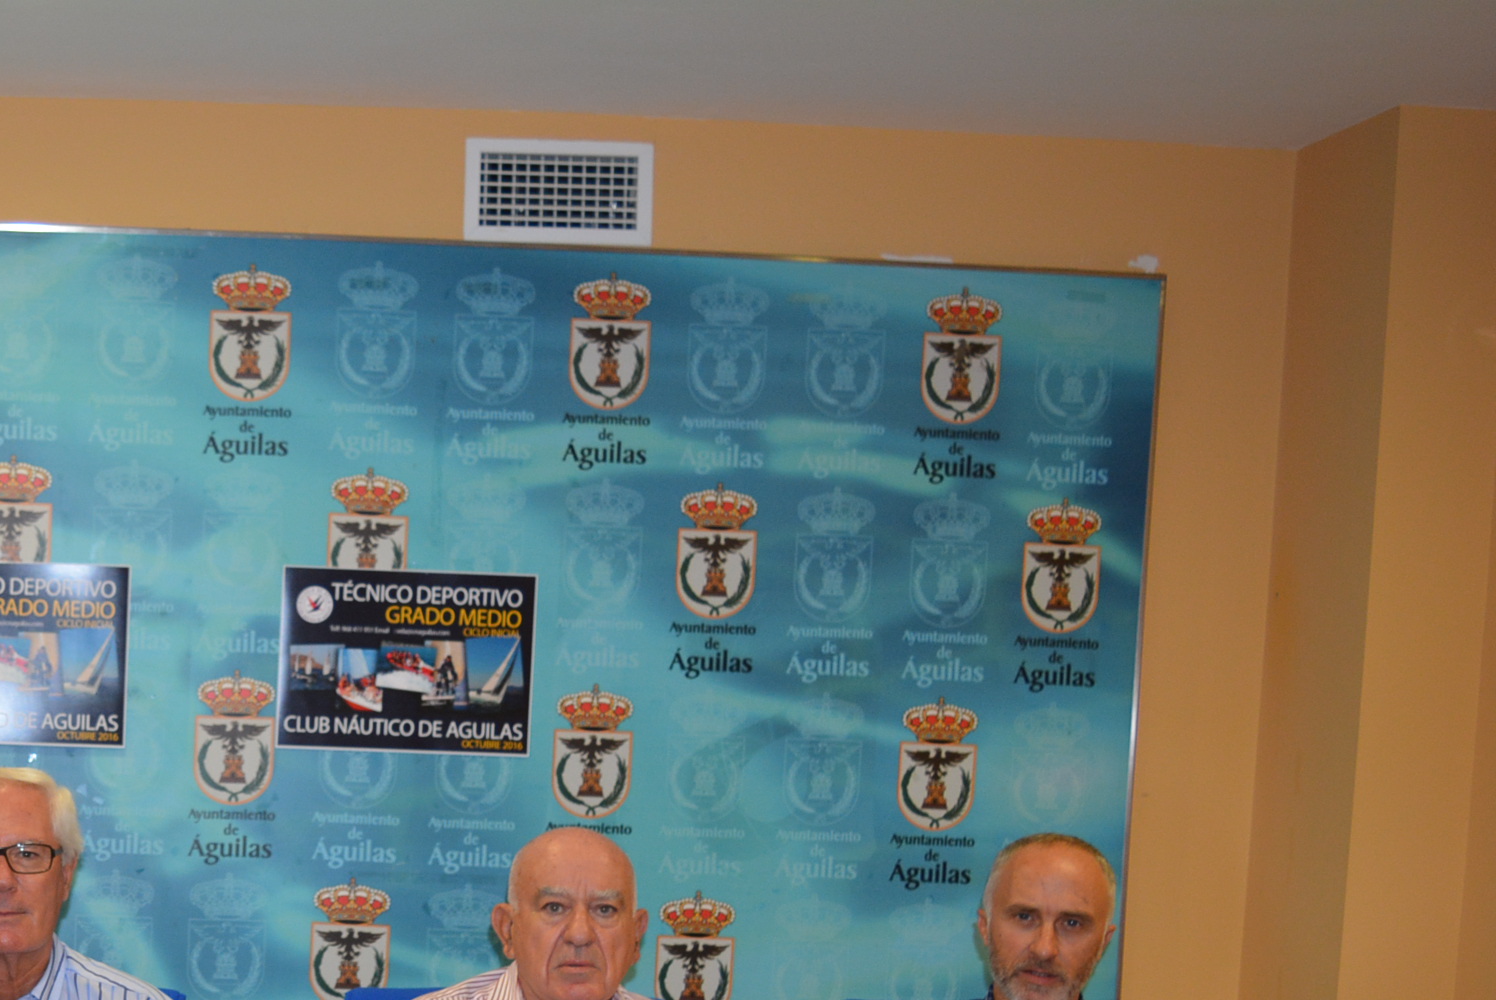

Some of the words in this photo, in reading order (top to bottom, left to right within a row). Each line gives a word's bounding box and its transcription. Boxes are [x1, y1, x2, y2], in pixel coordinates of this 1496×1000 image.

[203, 404, 292, 420] Ayuntamiento
[562, 412, 650, 428] Ayuntamiento
[239, 419, 255, 432] de
[598, 428, 614, 440] de
[914, 425, 1000, 442] Ayuntamiento
[203, 431, 289, 463] Águilas
[948, 441, 964, 454] de
[1027, 430, 1111, 448] Ayuntamiento
[562, 440, 647, 470] Águilas
[1062, 448, 1076, 460] de
[913, 453, 996, 484] Águilas
[1026, 460, 1108, 490] Águilas
[10, 577, 117, 598] DEPORTIVO
[331, 580, 412, 603] TÉCNICO
[416, 586, 523, 608] DEPORTIVO
[52, 600, 116, 618] MEDIO
[385, 606, 455, 626] GRADO
[459, 608, 522, 628] MEDIO
[56, 619, 84, 628] CICLO
[86, 620, 114, 628] INICIAL
[670, 620, 756, 637] Ayuntamiento
[786, 624, 873, 640] Ayuntamiento
[463, 628, 490, 636] CICLO
[491, 628, 519, 638] INICIAL
[902, 629, 988, 646] Ayuntamiento
[704, 636, 719, 648] de
[822, 640, 837, 652] de
[1014, 634, 1099, 651] Ayuntamiento
[937, 644, 952, 658] de
[1048, 650, 1063, 662] de
[669, 648, 752, 678] Águilas
[786, 652, 869, 682] Águilas
[902, 657, 984, 688] Águilas
[1014, 662, 1096, 693] Águilas
[14, 712, 37, 729] DE
[41, 713, 119, 732] AGUILAS
[284, 714, 330, 733] CLUB
[334, 715, 414, 736] NÁUTICO
[418, 720, 442, 737] DE
[446, 722, 523, 740] AGUILAS
[56, 732, 96, 741] OCTUBRE
[98, 732, 119, 742] 2016
[461, 740, 502, 749] OCTUBRE
[503, 742, 523, 750] 2016
[188, 808, 276, 823] Ayuntamiento
[312, 812, 400, 827] Ayuntamiento
[428, 816, 515, 832] Ayuntamiento
[224, 822, 238, 835] de
[348, 826, 362, 838] de
[464, 831, 478, 844] de
[890, 833, 975, 850] Ayuntamiento
[188, 835, 272, 865] Águilas
[312, 838, 396, 869] Águilas
[428, 842, 512, 873] Águilas
[925, 849, 940, 862] de
[889, 859, 971, 890] Águilas
